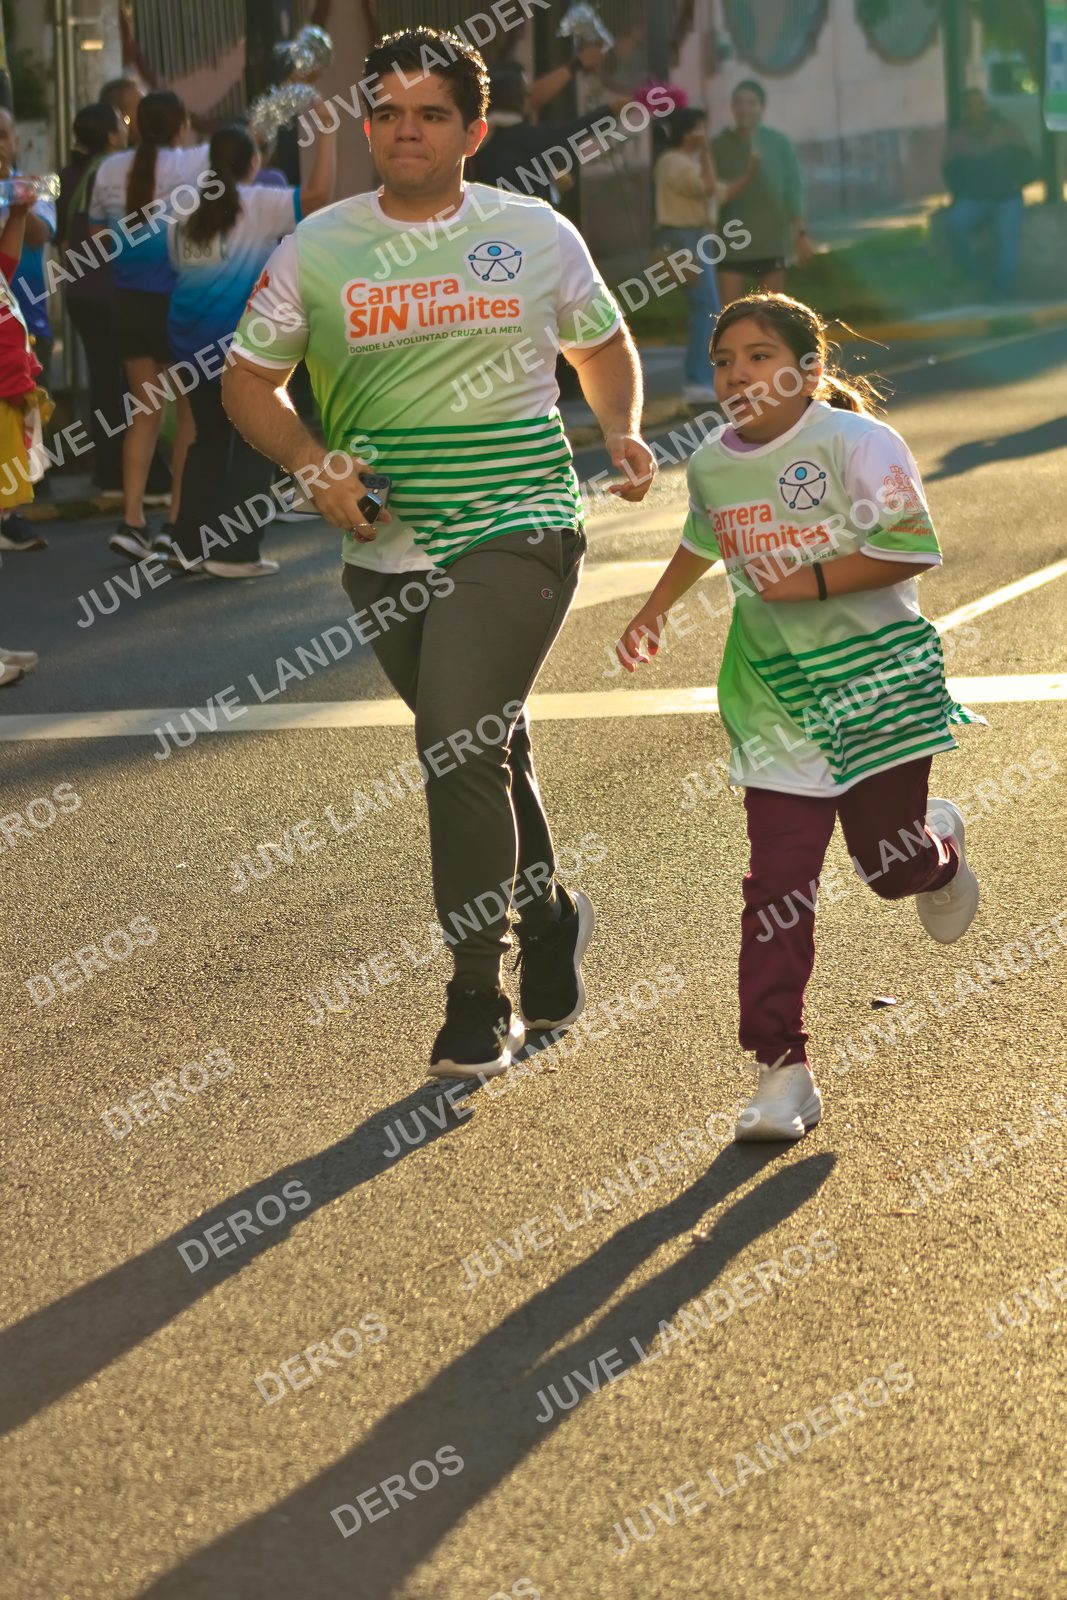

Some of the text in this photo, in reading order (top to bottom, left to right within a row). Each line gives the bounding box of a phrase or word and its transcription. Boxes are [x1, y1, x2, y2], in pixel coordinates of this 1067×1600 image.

[346, 278, 459, 307] Carrera
[350, 296, 521, 338] SIN límites
[350, 326, 522, 354] DONDE LA VOLUNTAD CRUZA LA META
[707, 504, 772, 533] arrera
[742, 524, 830, 556] límites
